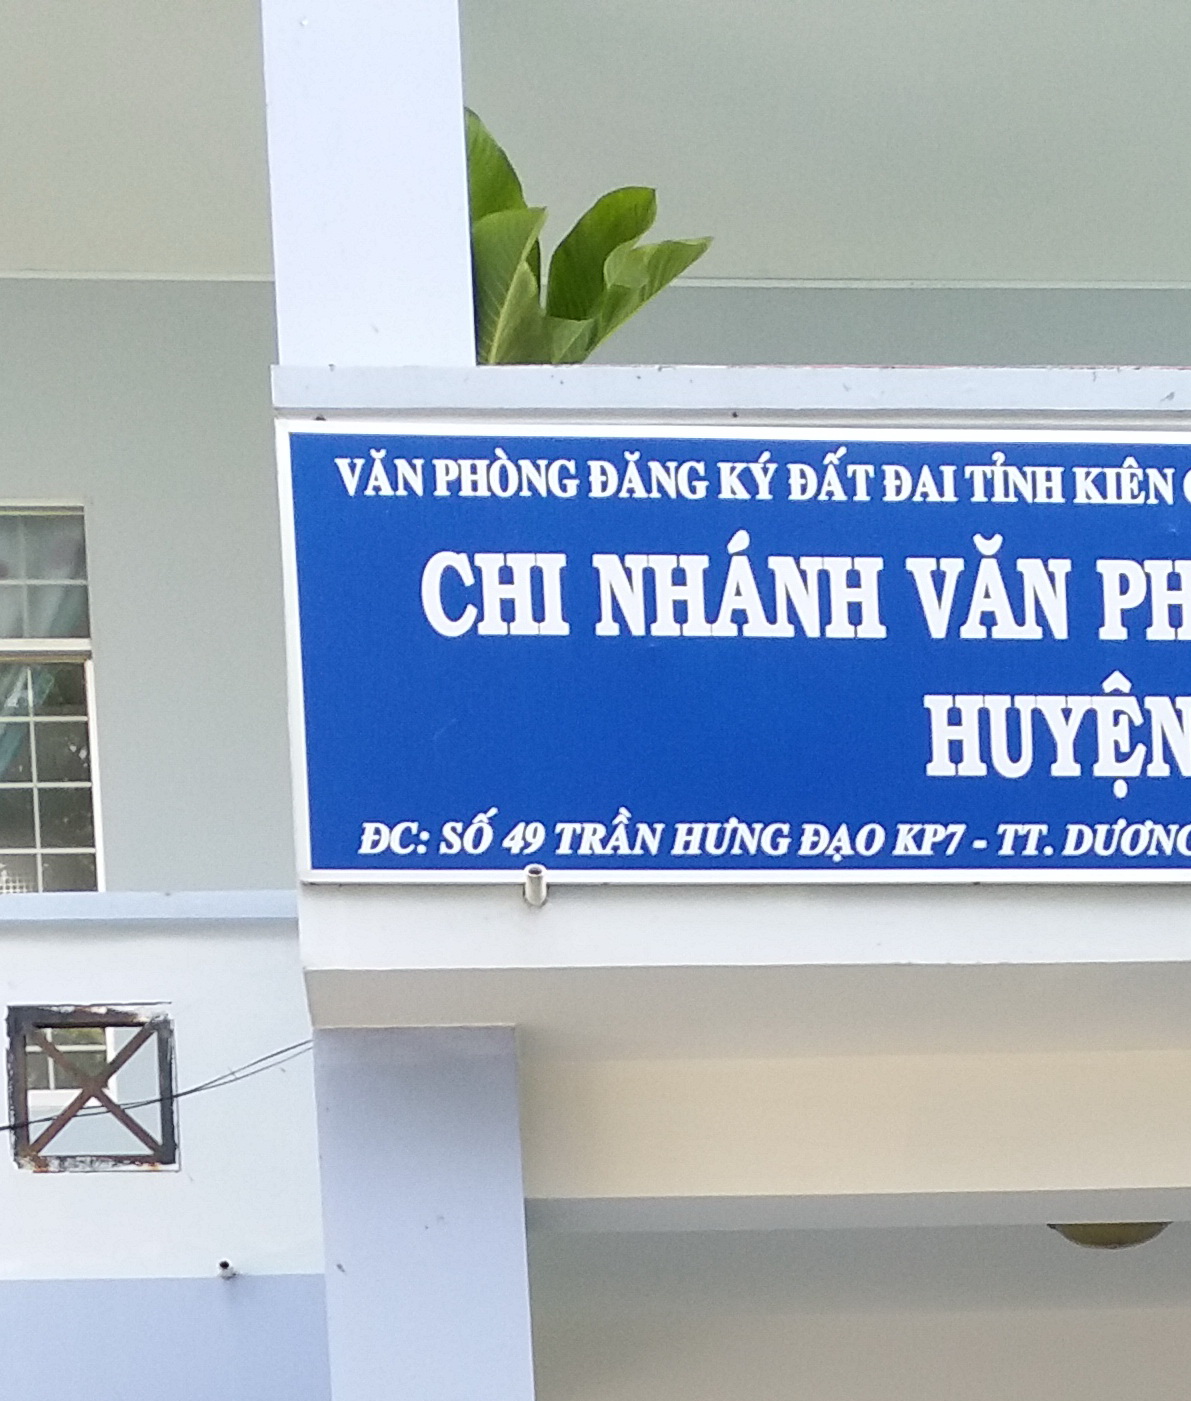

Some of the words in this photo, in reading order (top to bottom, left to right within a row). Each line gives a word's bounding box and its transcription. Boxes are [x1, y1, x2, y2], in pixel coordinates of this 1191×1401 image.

[335, 449, 424, 497] VĂN
[432, 447, 580, 499] PHÒNG
[587, 451, 709, 500] ĐĂNG
[717, 450, 778, 501] KÝ
[787, 446, 875, 502] ĐẤT
[882, 465, 958, 503] ĐAI
[965, 451, 1065, 504] TỈNH
[1073, 456, 1175, 505] KIÊN
[420, 550, 570, 638] CHI
[592, 529, 887, 639] NHÁNH
[905, 533, 1072, 640] VĂN
[358, 821, 430, 855] ĐC:
[440, 807, 498, 855] SỐ
[502, 821, 546, 855] 49
[555, 806, 665, 856] TRẦN
[671, 816, 792, 856] HƯNG
[798, 823, 885, 863] ĐẠO
[892, 823, 967, 856] KP7
[972, 839, 988, 849] -
[997, 823, 1054, 856] TT.
